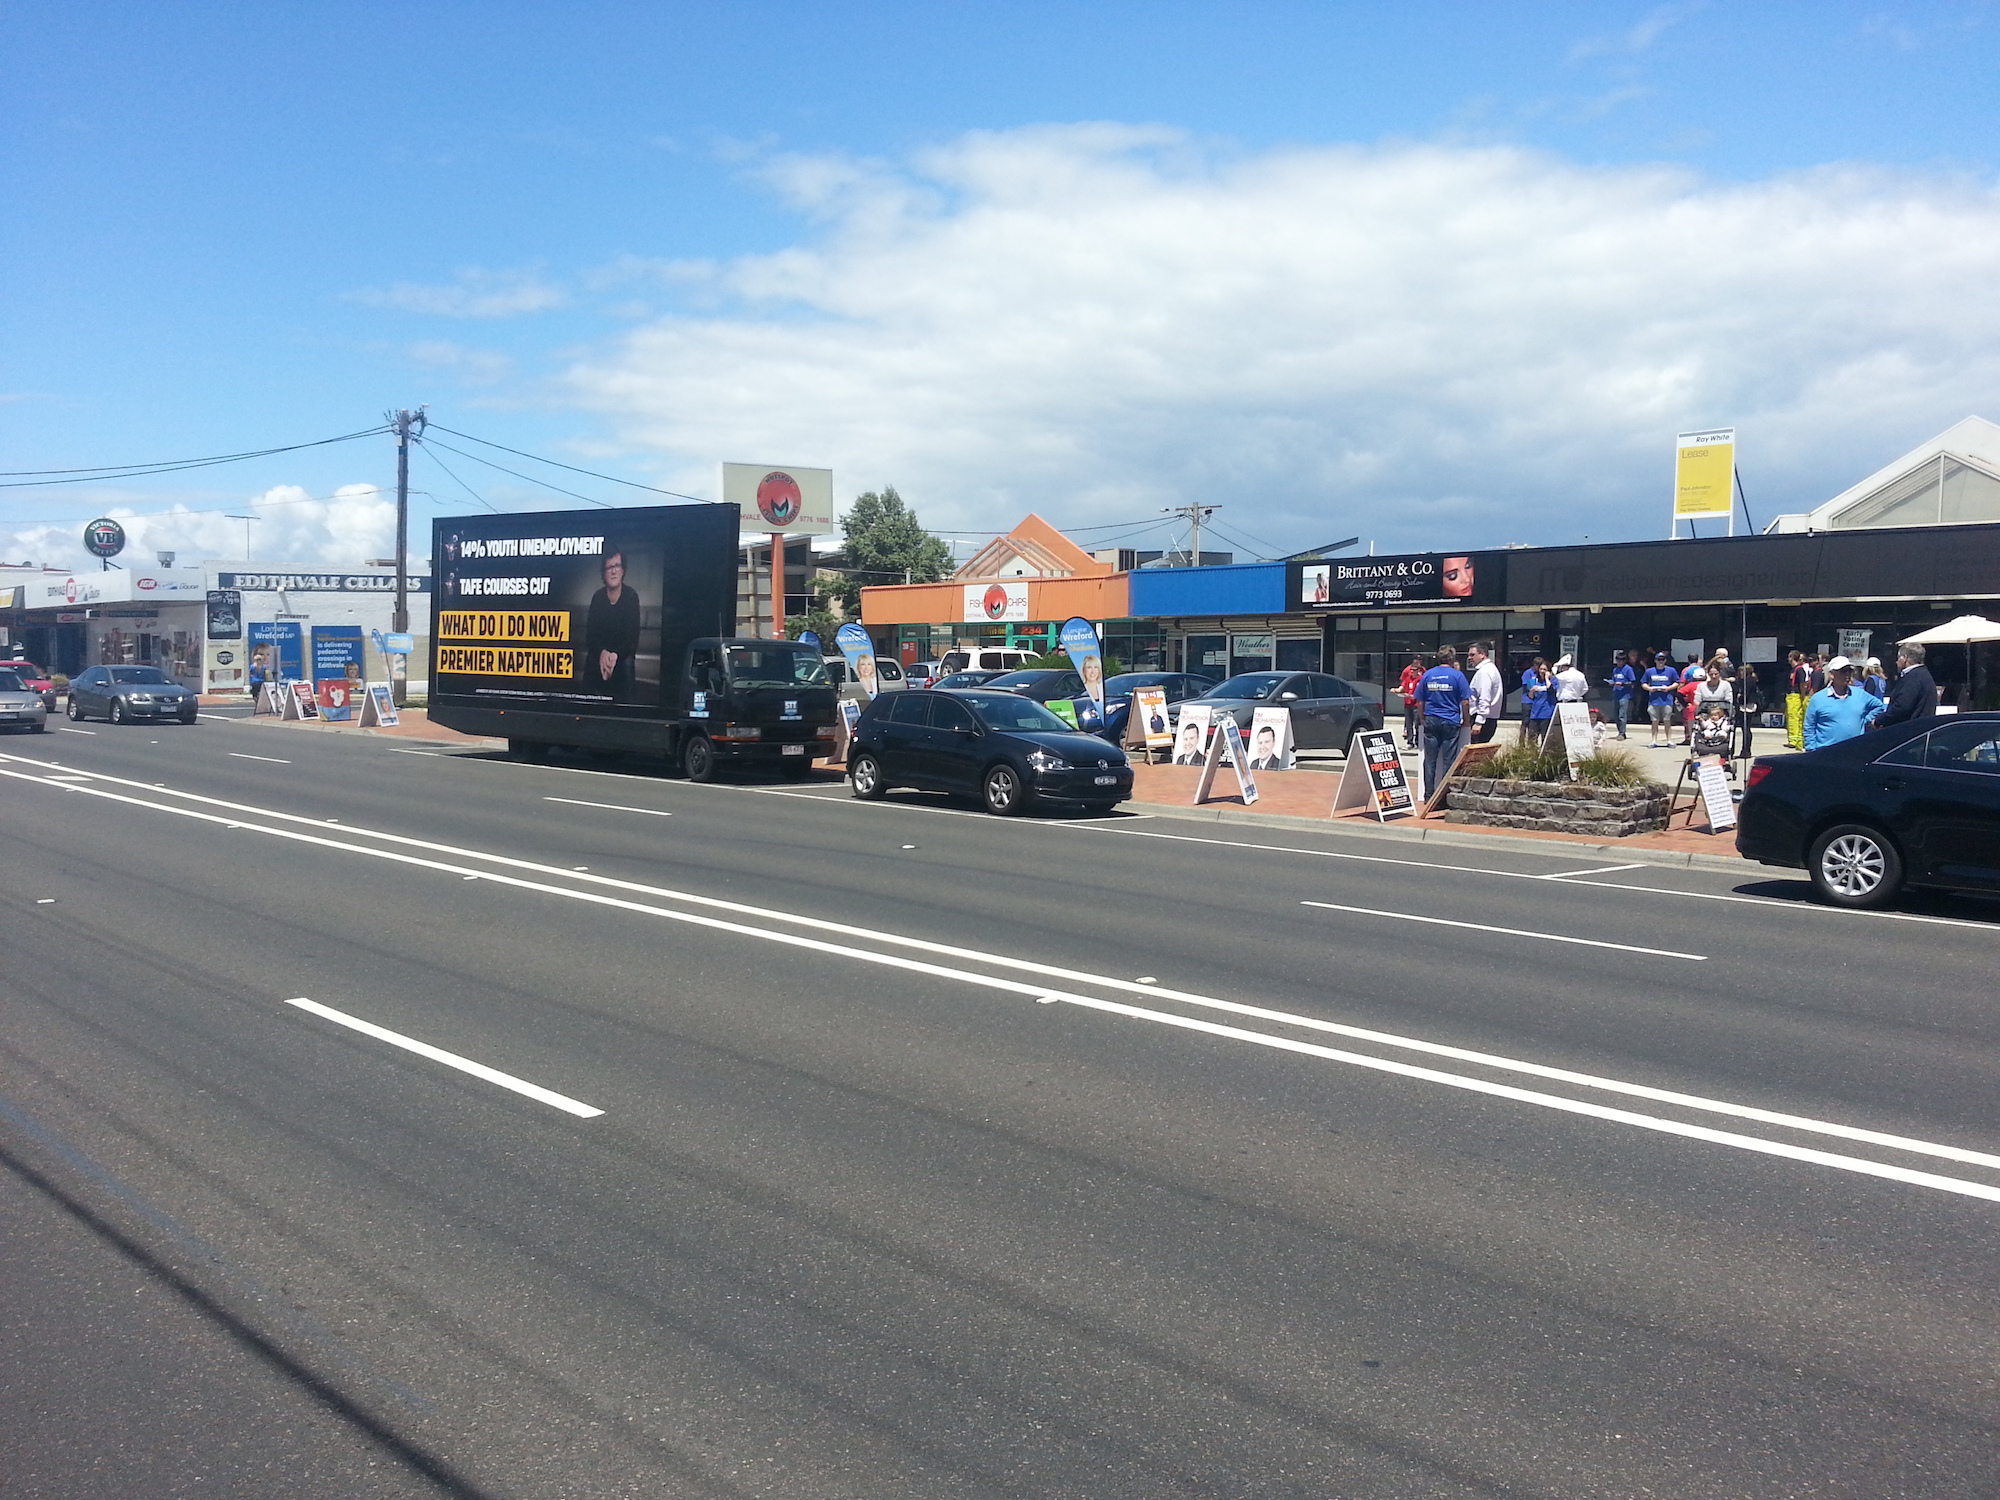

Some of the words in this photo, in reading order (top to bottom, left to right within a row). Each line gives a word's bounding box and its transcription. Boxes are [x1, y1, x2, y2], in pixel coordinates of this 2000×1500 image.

[1710, 434, 1730, 442] White
[1682, 449, 1709, 458] Lease
[95, 532, 115, 544] VB
[460, 540, 486, 558] 14%
[487, 539, 518, 557] YOUTH
[520, 536, 604, 556] UNEMPLOYMENT
[1337, 565, 1394, 579] BRITTANY
[1396, 562, 1408, 576] &
[234, 575, 340, 590] EDITHVALE
[460, 578, 483, 596] TAFE
[484, 577, 529, 595] COURSES
[530, 577, 550, 595] CUT
[1365, 591, 1383, 599] 9773
[1384, 590, 1402, 598] 0693
[970, 599, 983, 608] FISH
[1008, 598, 1027, 607] CHIPS
[442, 614, 476, 636] WHAT
[479, 615, 496, 636] DO
[500, 616, 503, 636] I
[508, 615, 525, 637] DO
[529, 616, 563, 641] NOW,
[1021, 626, 1043, 635] 234
[1062, 631, 1093, 641] Wreford
[1236, 636, 1270, 648] Weather
[440, 650, 494, 672] PREMIER
[498, 651, 572, 675] NAPTHINE?
[1370, 736, 1386, 746] TELL
[1366, 744, 1394, 756] MINISTER
[1372, 752, 1393, 763] WELLS
[1370, 762, 1384, 772] FIRE
[1384, 760, 1399, 770] CUTS
[1379, 769, 1395, 779] COST
[1381, 777, 1399, 787] LIVES
